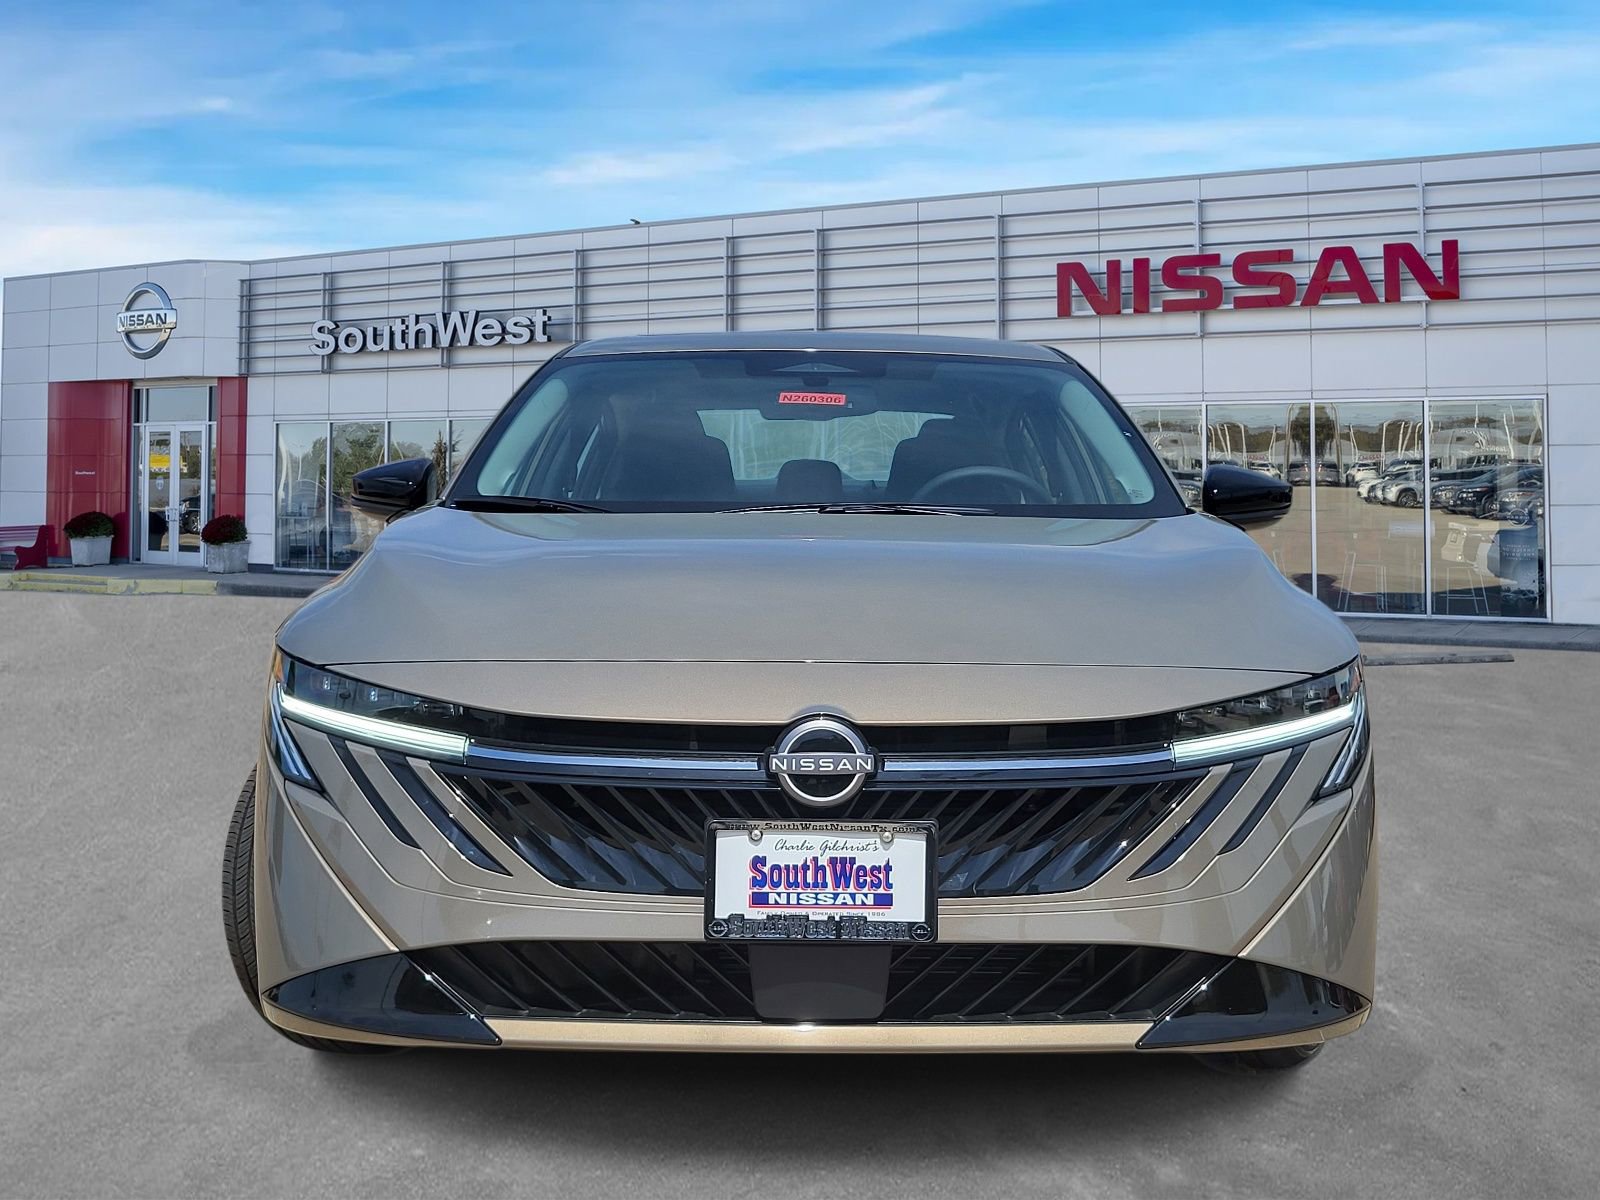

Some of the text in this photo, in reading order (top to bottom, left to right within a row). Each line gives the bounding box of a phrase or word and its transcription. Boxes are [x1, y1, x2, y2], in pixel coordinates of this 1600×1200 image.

[1057, 239, 1460, 318] NISSAN
[119, 312, 167, 329] NISSAN
[309, 308, 551, 356] SouthWest
[782, 394, 842, 404] N260306
[772, 758, 872, 771] NISSAN
[774, 838, 880, 857] Charlie Gilchrist's
[749, 855, 893, 891] SouthWest
[768, 892, 875, 906] NISSAN
